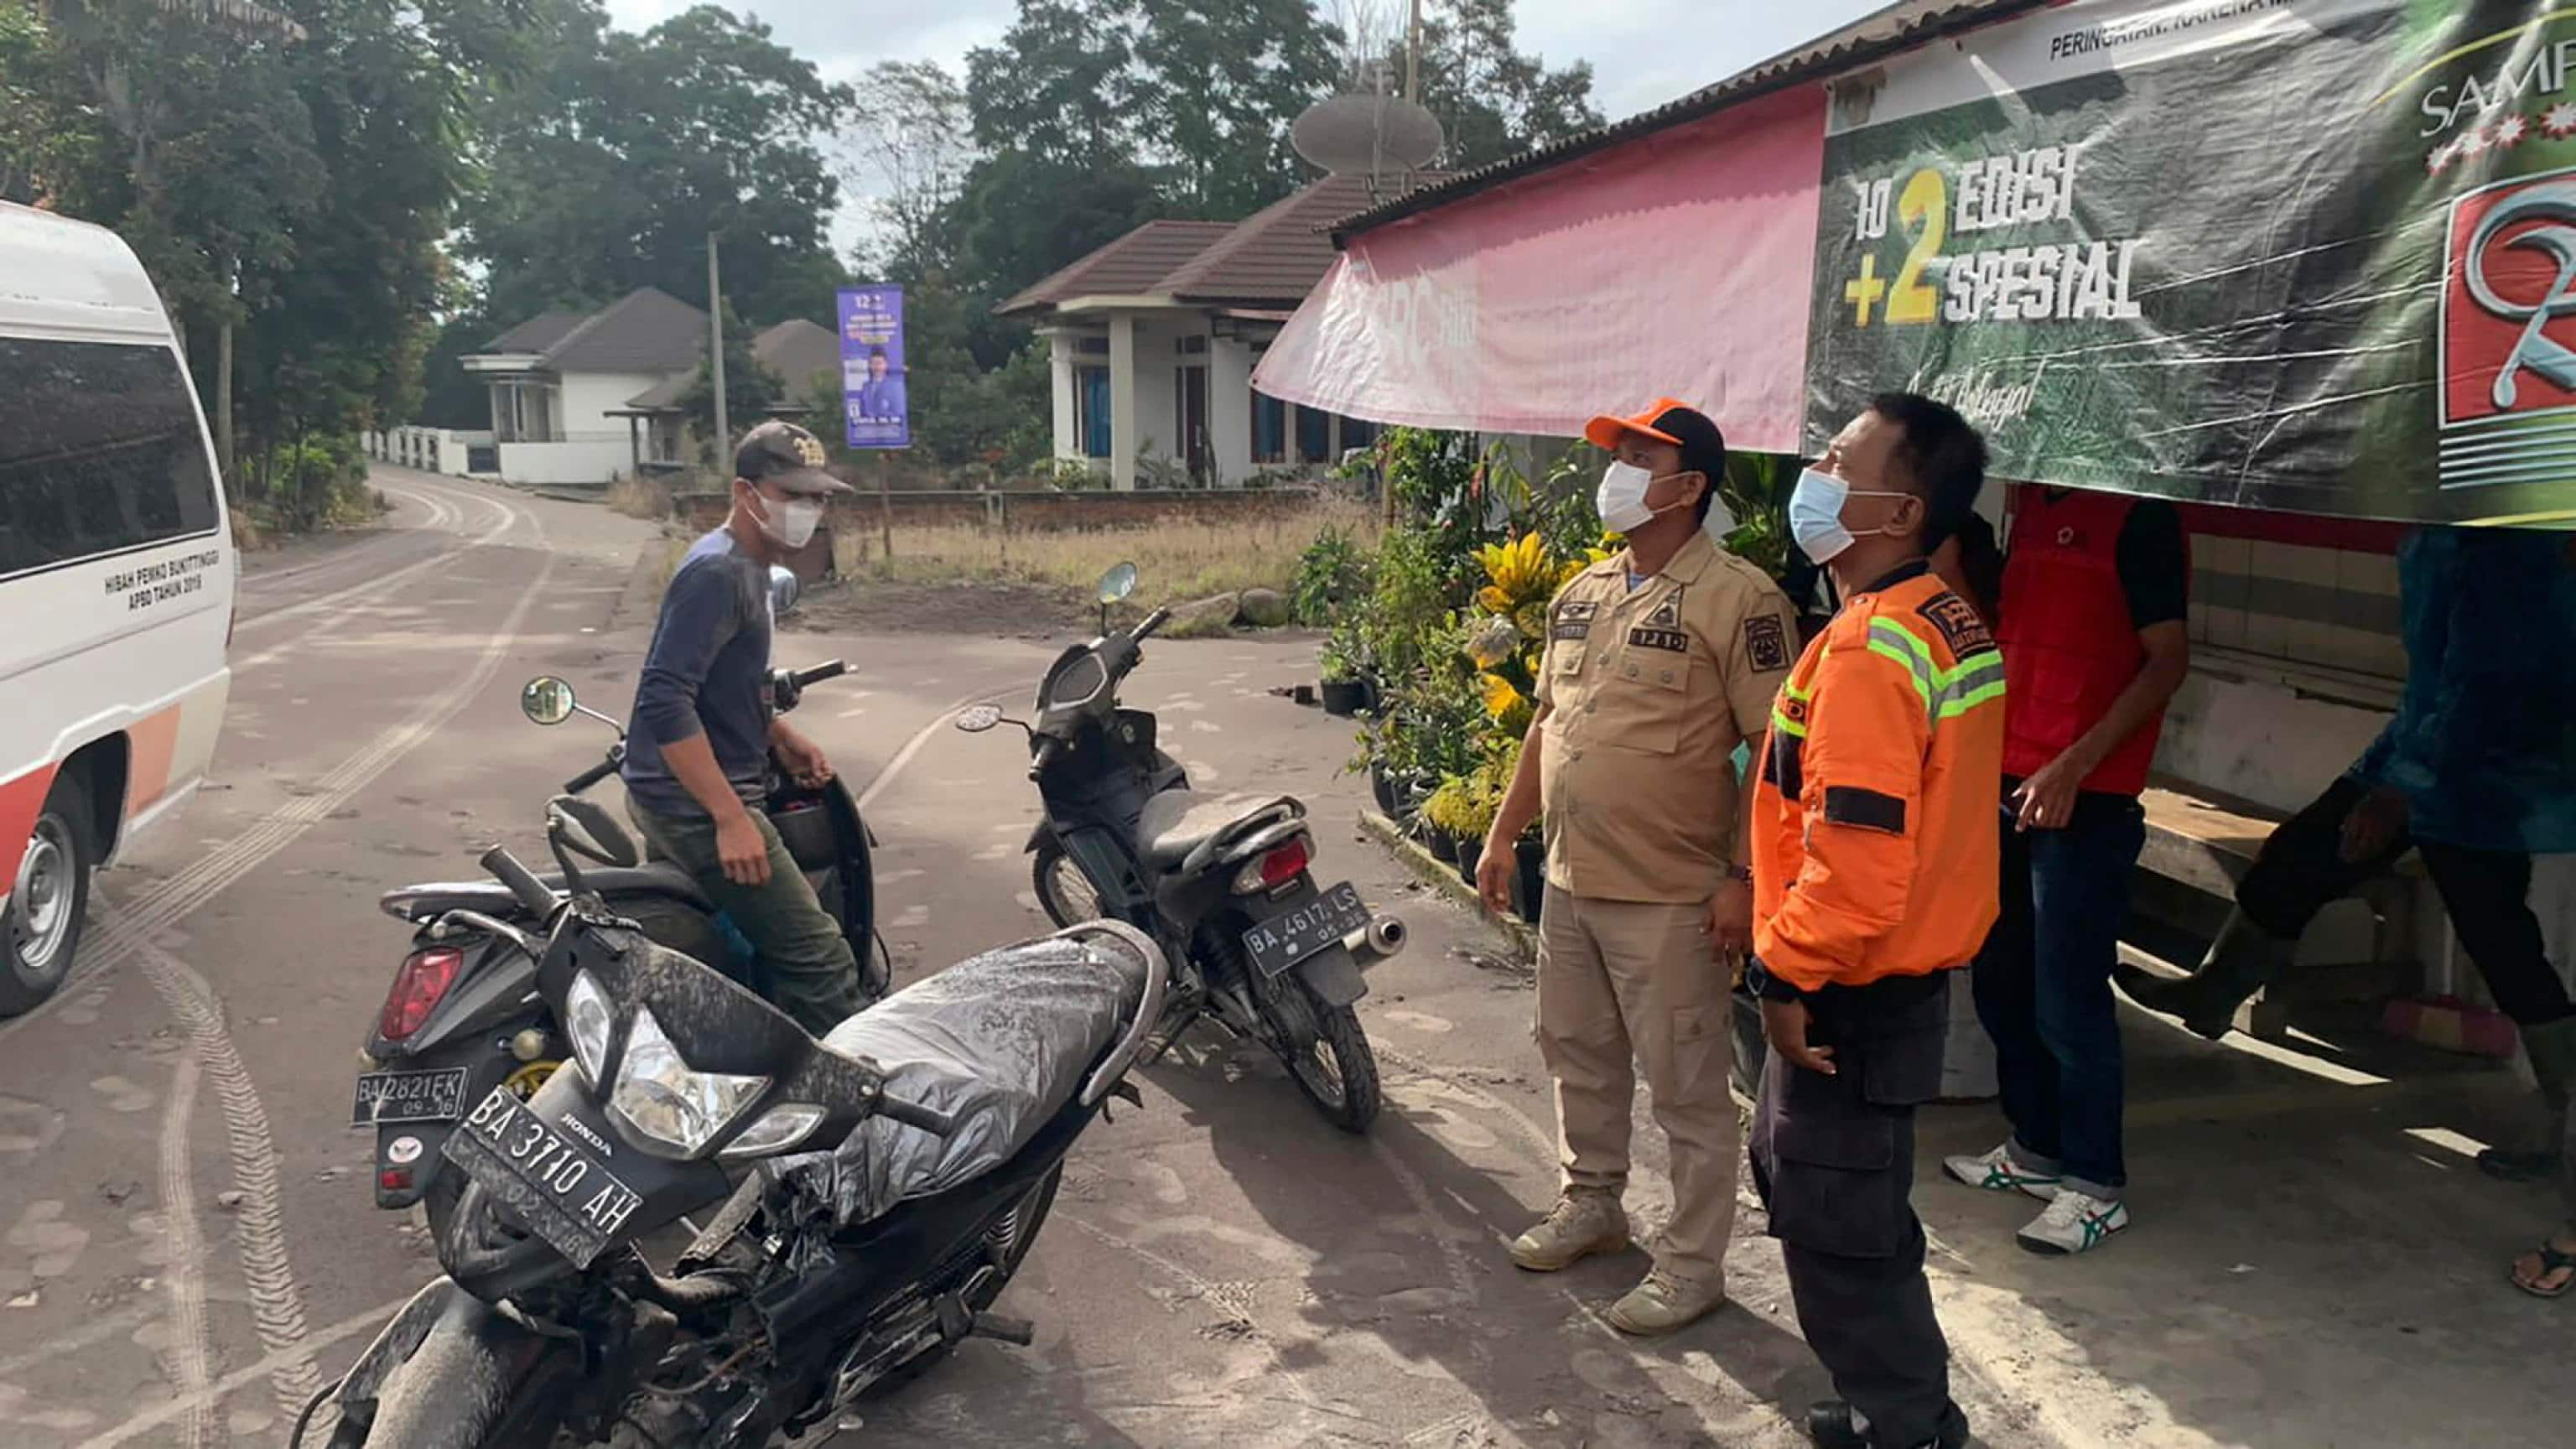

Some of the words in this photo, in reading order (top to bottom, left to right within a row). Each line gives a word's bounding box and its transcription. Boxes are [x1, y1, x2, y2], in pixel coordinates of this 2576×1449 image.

[1856, 178, 1893, 242] 10
[1955, 143, 2079, 232] EDISI
[1943, 237, 2142, 322] SPESIAL
[128, 588, 153, 611] APBD
[153, 580, 182, 603] TAHUN
[1332, 888, 1358, 912] LS
[358, 1079, 381, 1103] BA
[387, 1076, 432, 1100] 2821
[561, 1112, 612, 1157] HONDA
[470, 1090, 518, 1140] BA
[511, 1123, 588, 1194] 3710
[581, 1183, 636, 1235] AH
